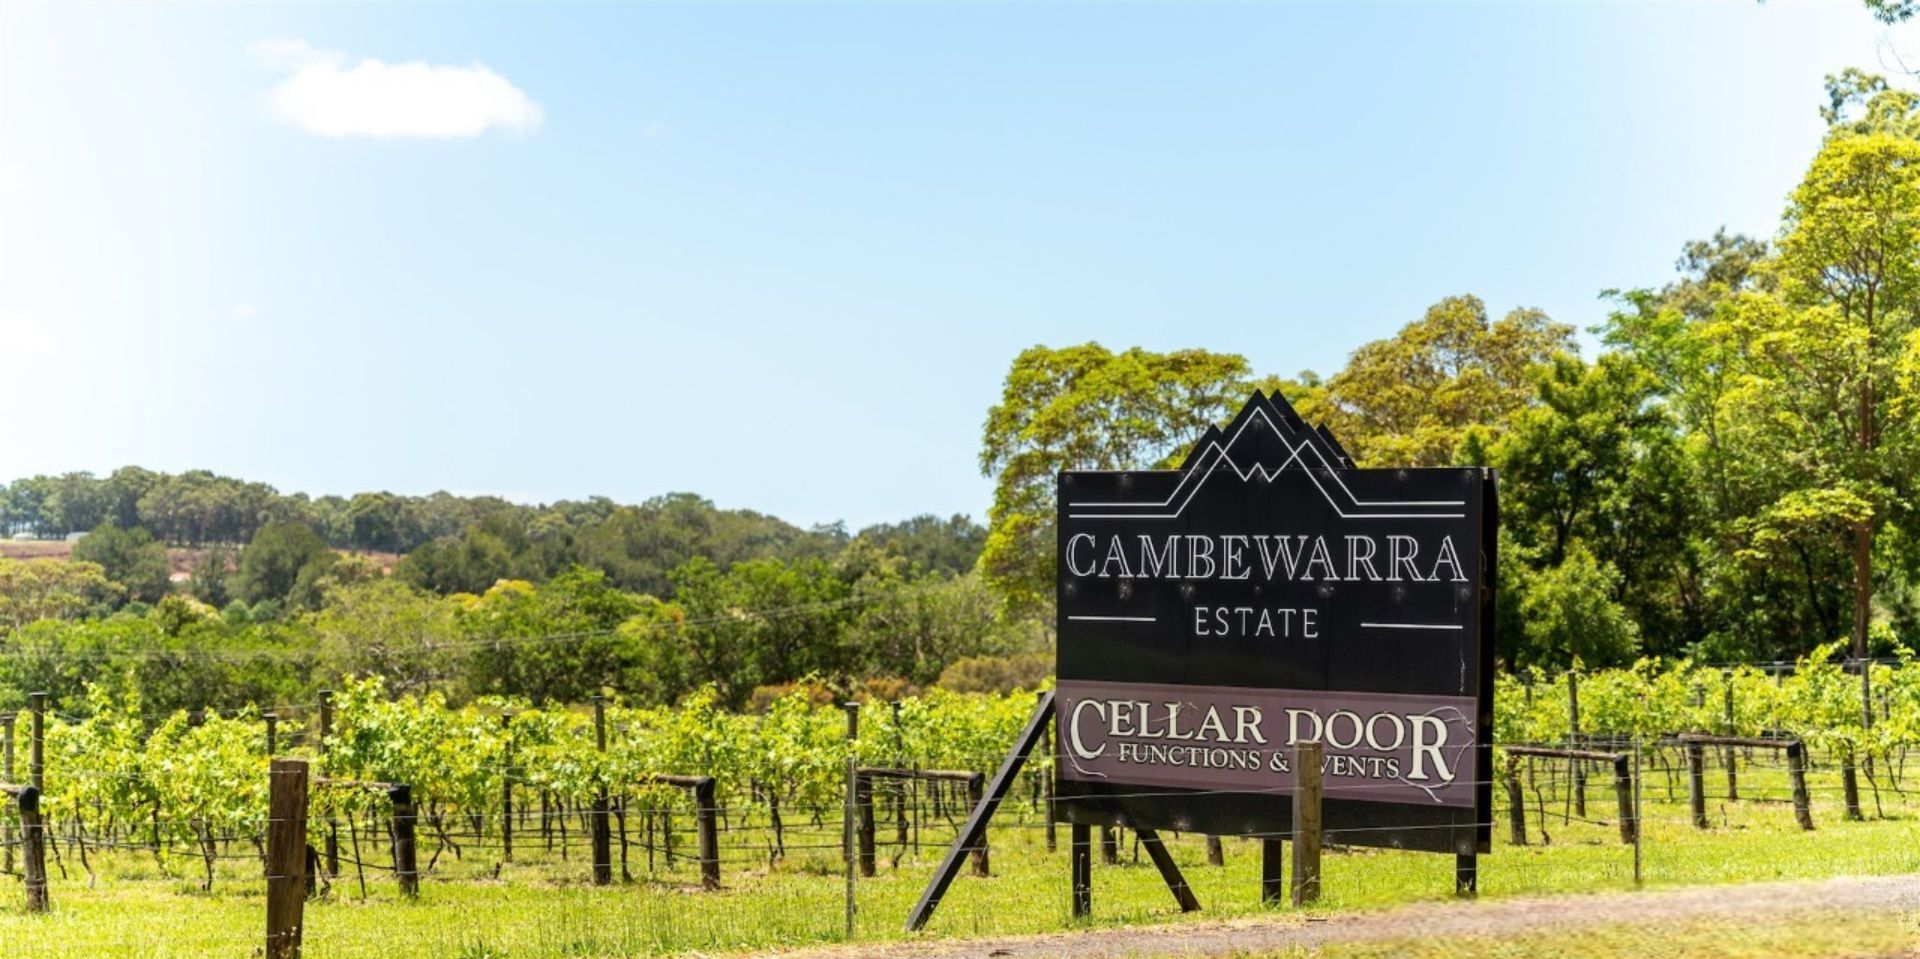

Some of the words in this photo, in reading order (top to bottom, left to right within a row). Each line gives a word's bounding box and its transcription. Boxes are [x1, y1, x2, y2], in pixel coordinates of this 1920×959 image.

[1065, 533, 1469, 582] CAMBEWARRA
[1194, 607, 1319, 638] ESTATE
[1070, 699, 1267, 760] CELLAR
[1285, 708, 1456, 781] DOOR
[1118, 743, 1261, 771] FUNCTIONS
[1269, 751, 1290, 773] &
[1314, 754, 1400, 780] VENTS
